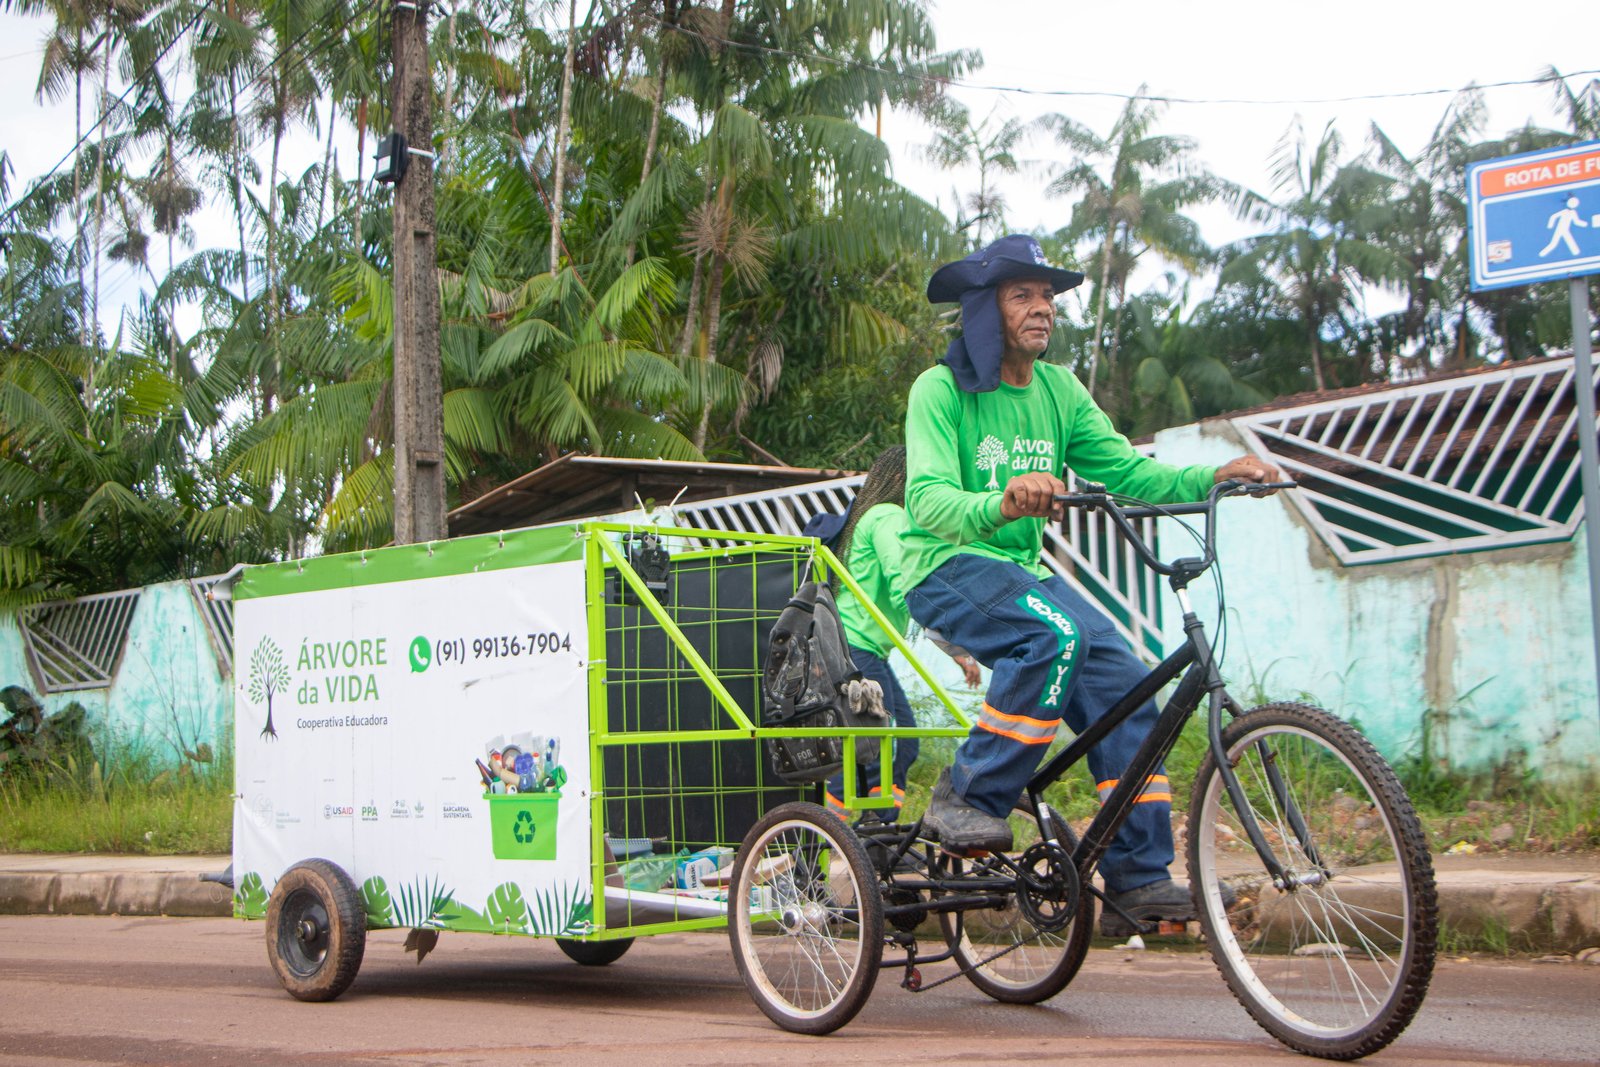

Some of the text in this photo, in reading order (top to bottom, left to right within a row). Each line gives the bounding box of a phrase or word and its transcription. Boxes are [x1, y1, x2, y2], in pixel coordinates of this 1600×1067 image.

[1504, 166, 1552, 187] ROTA
[1555, 160, 1582, 178] DE
[296, 636, 388, 672] ÁRVORE
[435, 632, 572, 666] (91) 99136-7904
[297, 673, 380, 705] da VIDA
[1045, 664, 1069, 706] VIDA
[296, 714, 388, 731] Cooperativa Educadora
[333, 806, 354, 815] USAID
[361, 806, 378, 817] PPA
